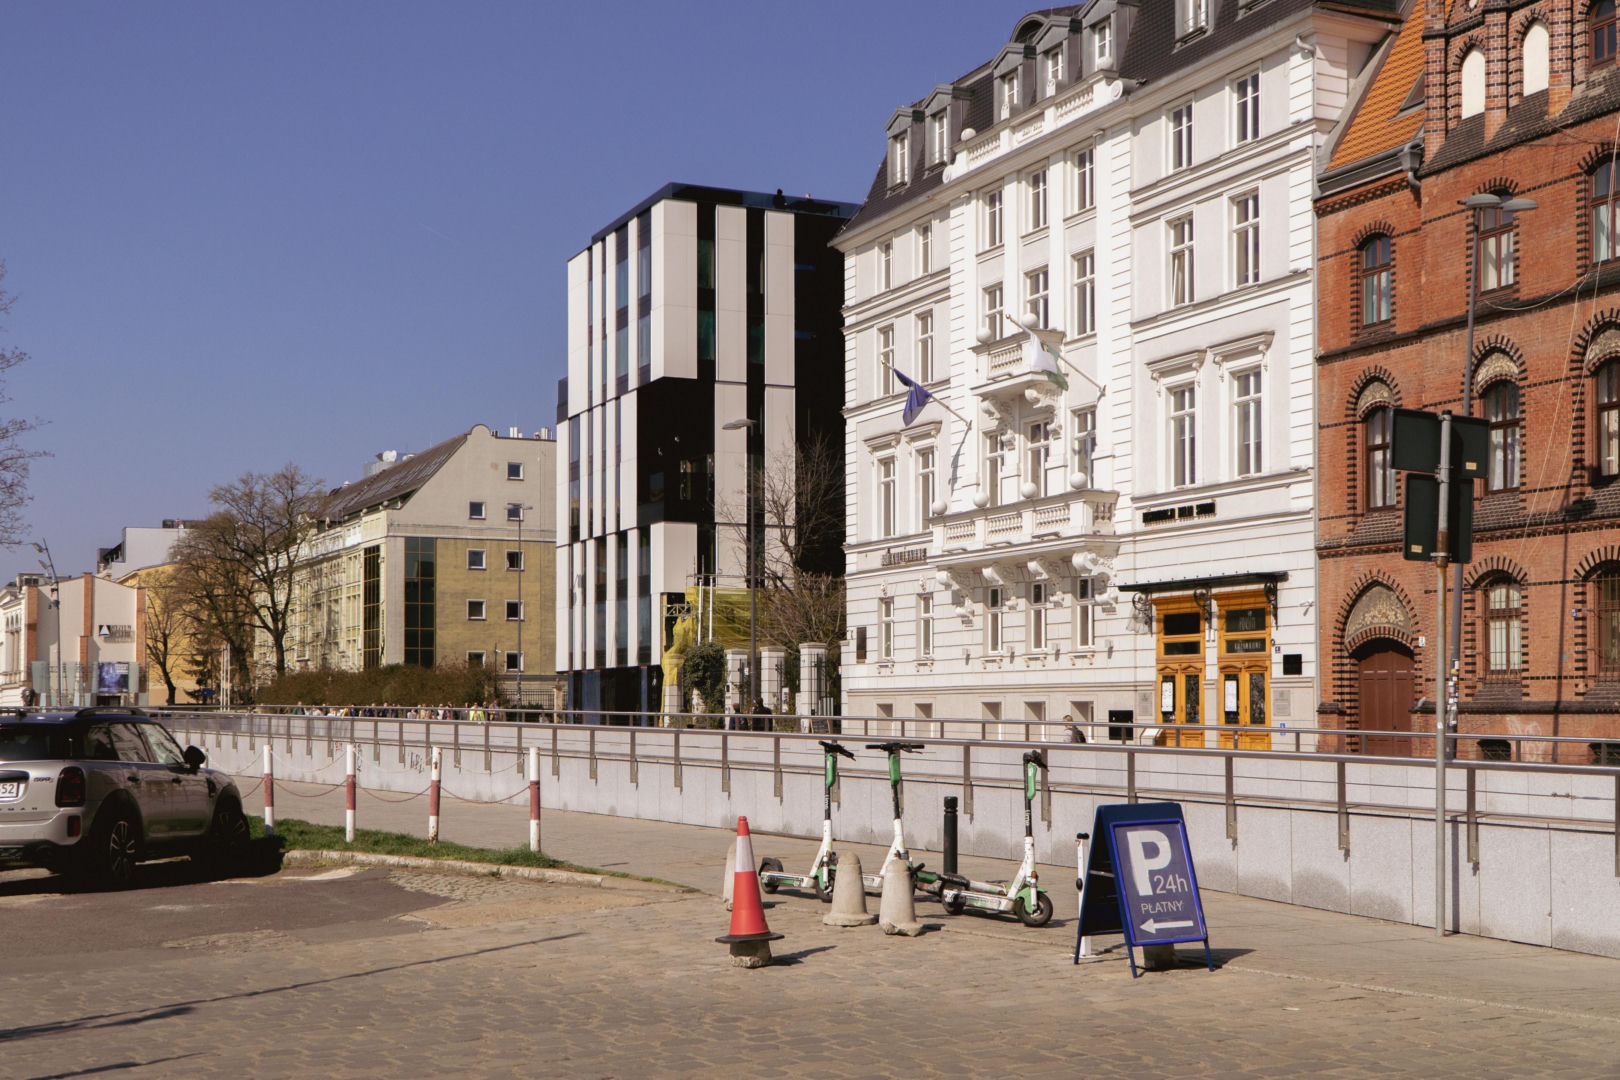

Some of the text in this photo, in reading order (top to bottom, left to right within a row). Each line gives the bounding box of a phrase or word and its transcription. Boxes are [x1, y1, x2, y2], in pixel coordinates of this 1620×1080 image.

[1126, 830, 1172, 896] P
[1154, 874, 1188, 894] 24h
[1141, 901, 1183, 914] PŁATNY
